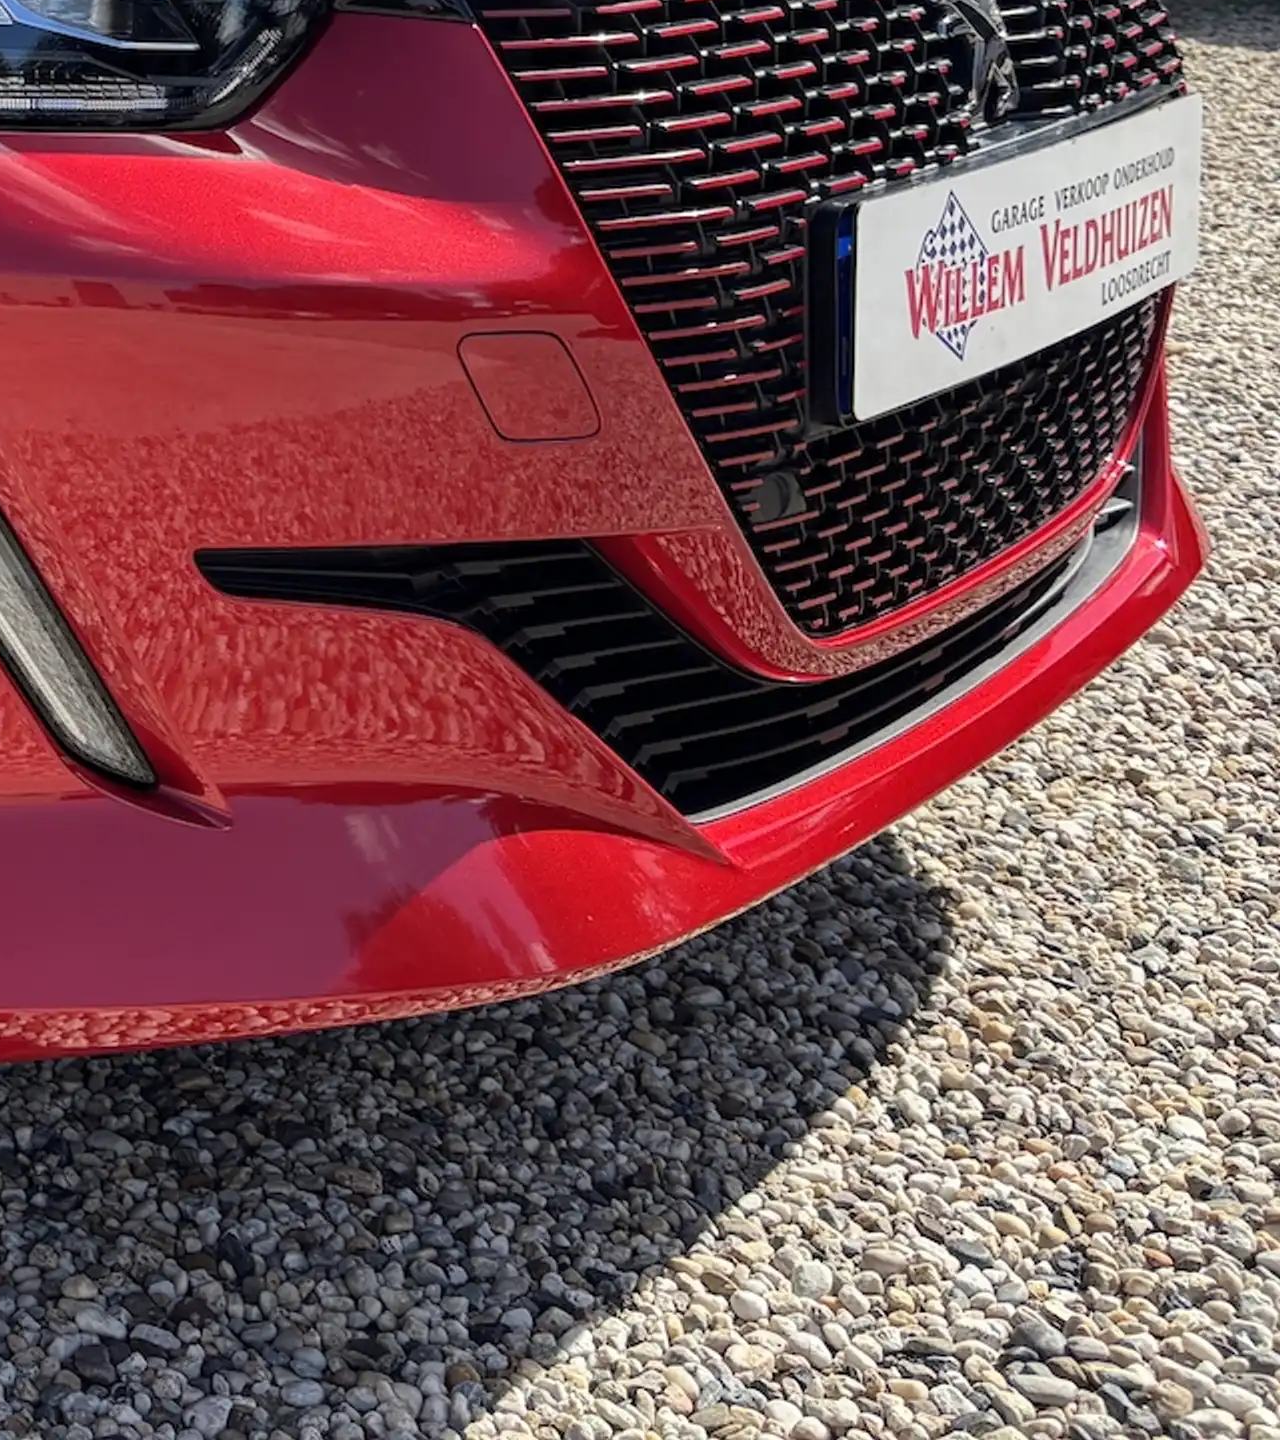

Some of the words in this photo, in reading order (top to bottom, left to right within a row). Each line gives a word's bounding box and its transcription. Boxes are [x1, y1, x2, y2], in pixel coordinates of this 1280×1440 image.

[991, 195, 1045, 234] GARAGE
[1054, 172, 1110, 213] VERKOOP
[1113, 146, 1176, 190] ONDERHOUD
[904, 244, 1026, 340] WILLEM
[1040, 184, 1175, 292] VELDHUIZEN
[1101, 250, 1173, 306] LOOSDRECHT
